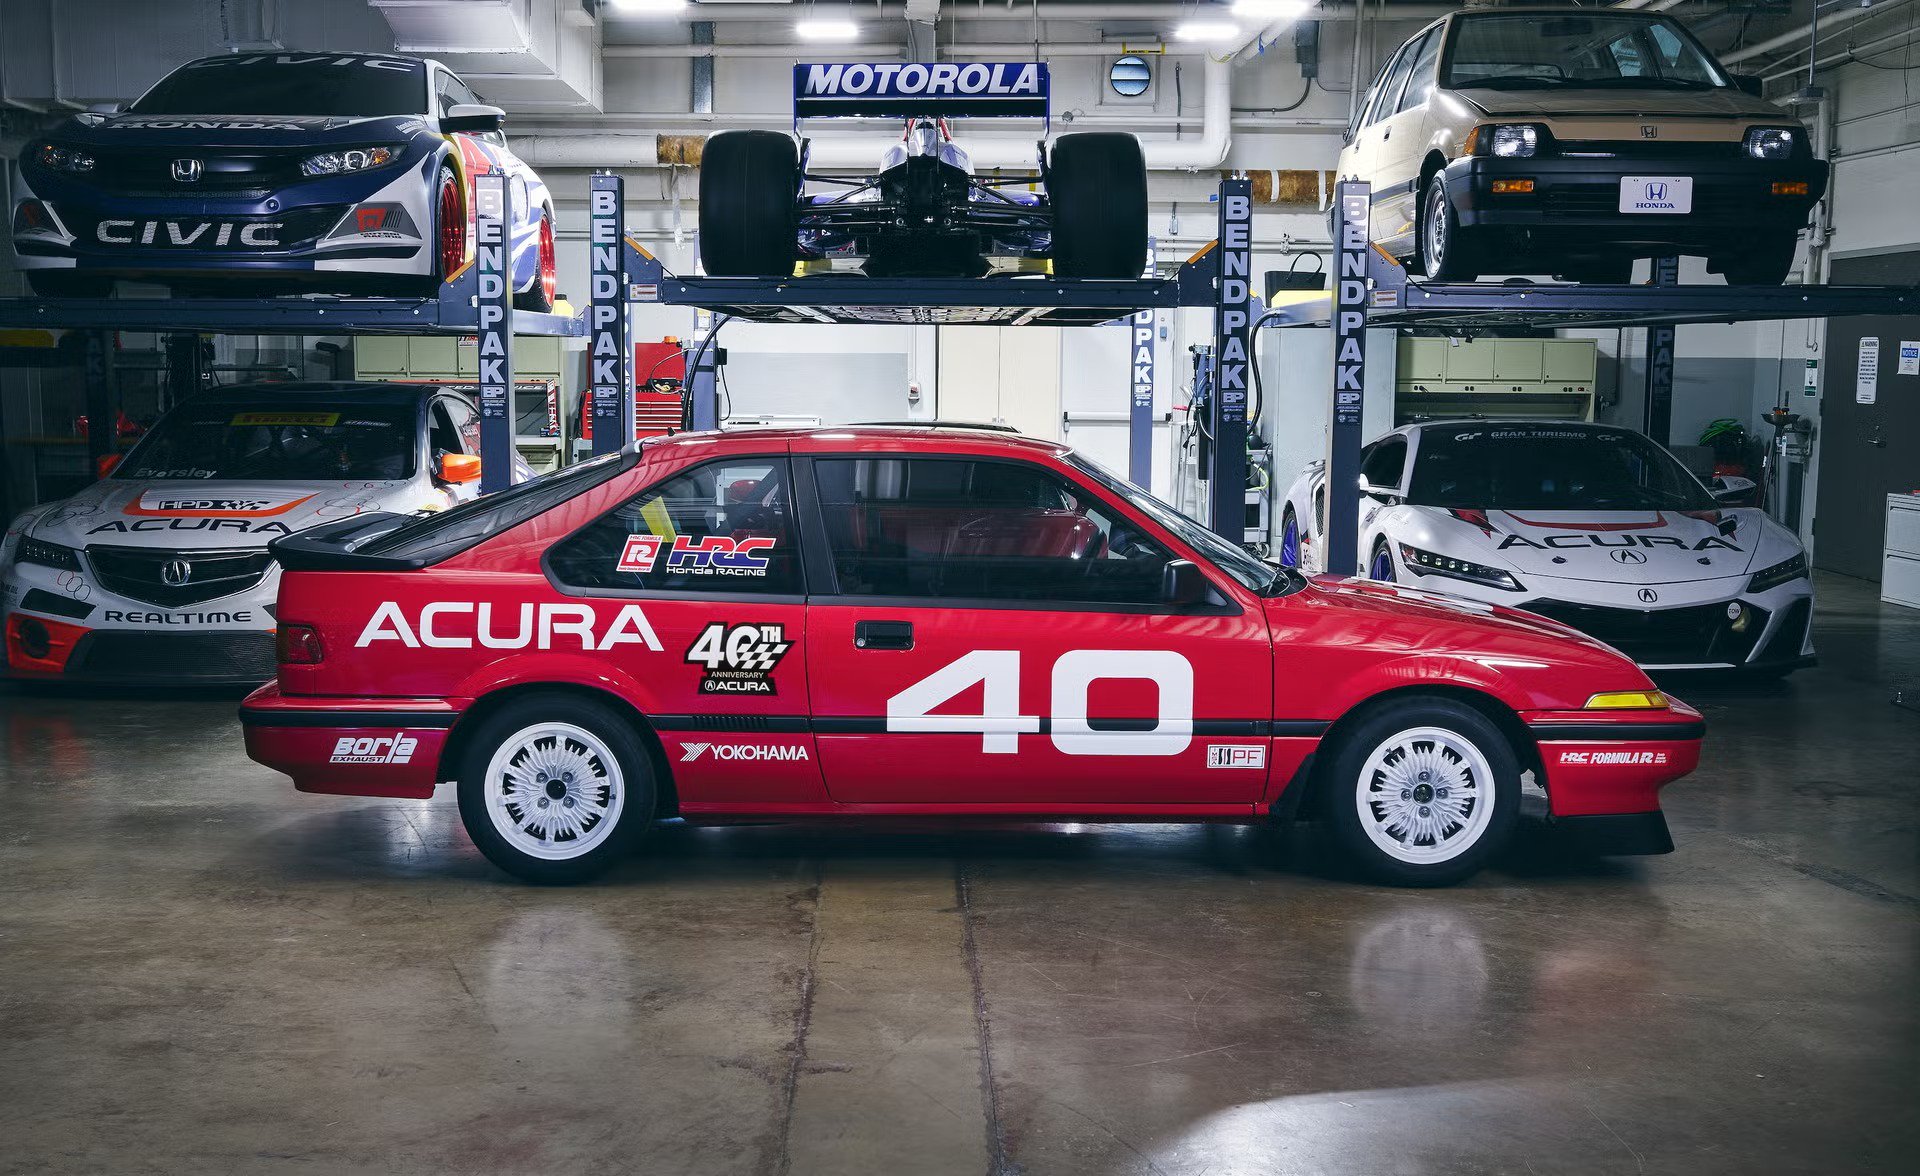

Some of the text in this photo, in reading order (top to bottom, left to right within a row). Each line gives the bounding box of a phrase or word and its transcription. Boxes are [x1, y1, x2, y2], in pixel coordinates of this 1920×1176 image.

[187, 57, 416, 71] CIVIC
[805, 64, 1039, 94] MOTOROLA
[108, 121, 305, 130] HONDA
[97, 220, 284, 246] CIVIC
[477, 189, 505, 383] BENDPAK
[593, 190, 618, 383] BENDPAK
[1221, 195, 1249, 389] BENDPAK
[1336, 195, 1368, 390] BENDPAK
[483, 387, 504, 397] BP
[596, 387, 617, 397] BP
[1223, 392, 1245, 403] BP
[1339, 393, 1360, 403] BP
[160, 501, 211, 509] HPD
[85, 519, 293, 535] ACURA
[1497, 535, 1744, 552] ACURA
[666, 535, 776, 568] HRC
[666, 567, 766, 576] Honda RACING
[105, 611, 251, 624] REALTIME
[355, 602, 664, 651] ACURA
[711, 671, 764, 679] ANNIVERSARY
[716, 681, 770, 691] ACURA
[886, 650, 1194, 756] 40
[711, 744, 809, 760] YOKOHAMA
[1233, 750, 1261, 764] PF
[1560, 752, 1590, 762] HRC
[1590, 752, 1640, 764] FORMULA
